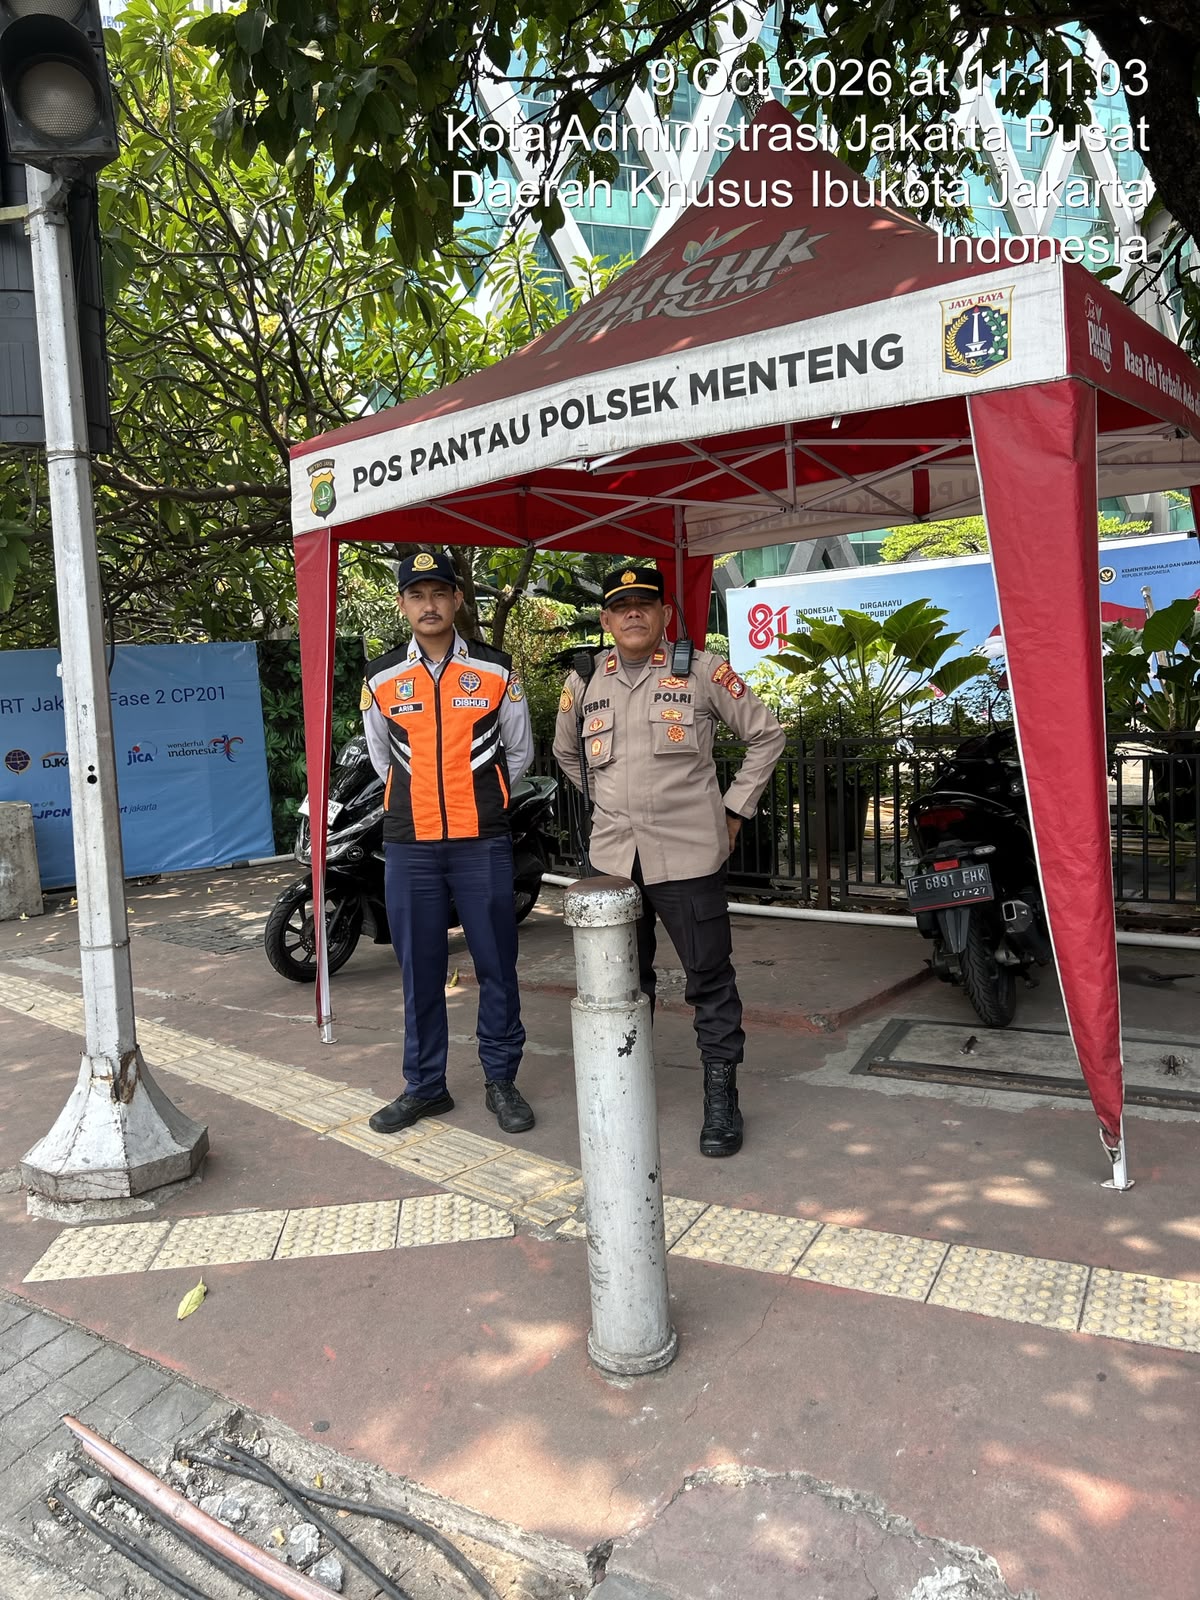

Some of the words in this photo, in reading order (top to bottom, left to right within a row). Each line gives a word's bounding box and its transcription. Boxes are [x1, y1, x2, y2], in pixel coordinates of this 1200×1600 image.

[948, 298, 974, 310] JAYA
[977, 291, 1004, 304] RAYA
[1124, 341, 1143, 379] Rasa
[1144, 353, 1158, 388] Teh
[352, 454, 403, 493] POS
[410, 413, 531, 476] PANTAU
[538, 377, 680, 438] POLSEK
[689, 333, 904, 406] MENTENG
[795, 606, 834, 616] INDONESIA
[860, 599, 902, 610] DIRGAHAYU
[155, 689, 166, 704] 2
[171, 686, 225, 704] CP201
[455, 699, 486, 707] DISHUB
[654, 692, 692, 704] POLRI
[583, 698, 610, 715] FEBRI
[129, 803, 157, 815] jakarta
[911, 880, 919, 893] F
[925, 874, 954, 890] 6891
